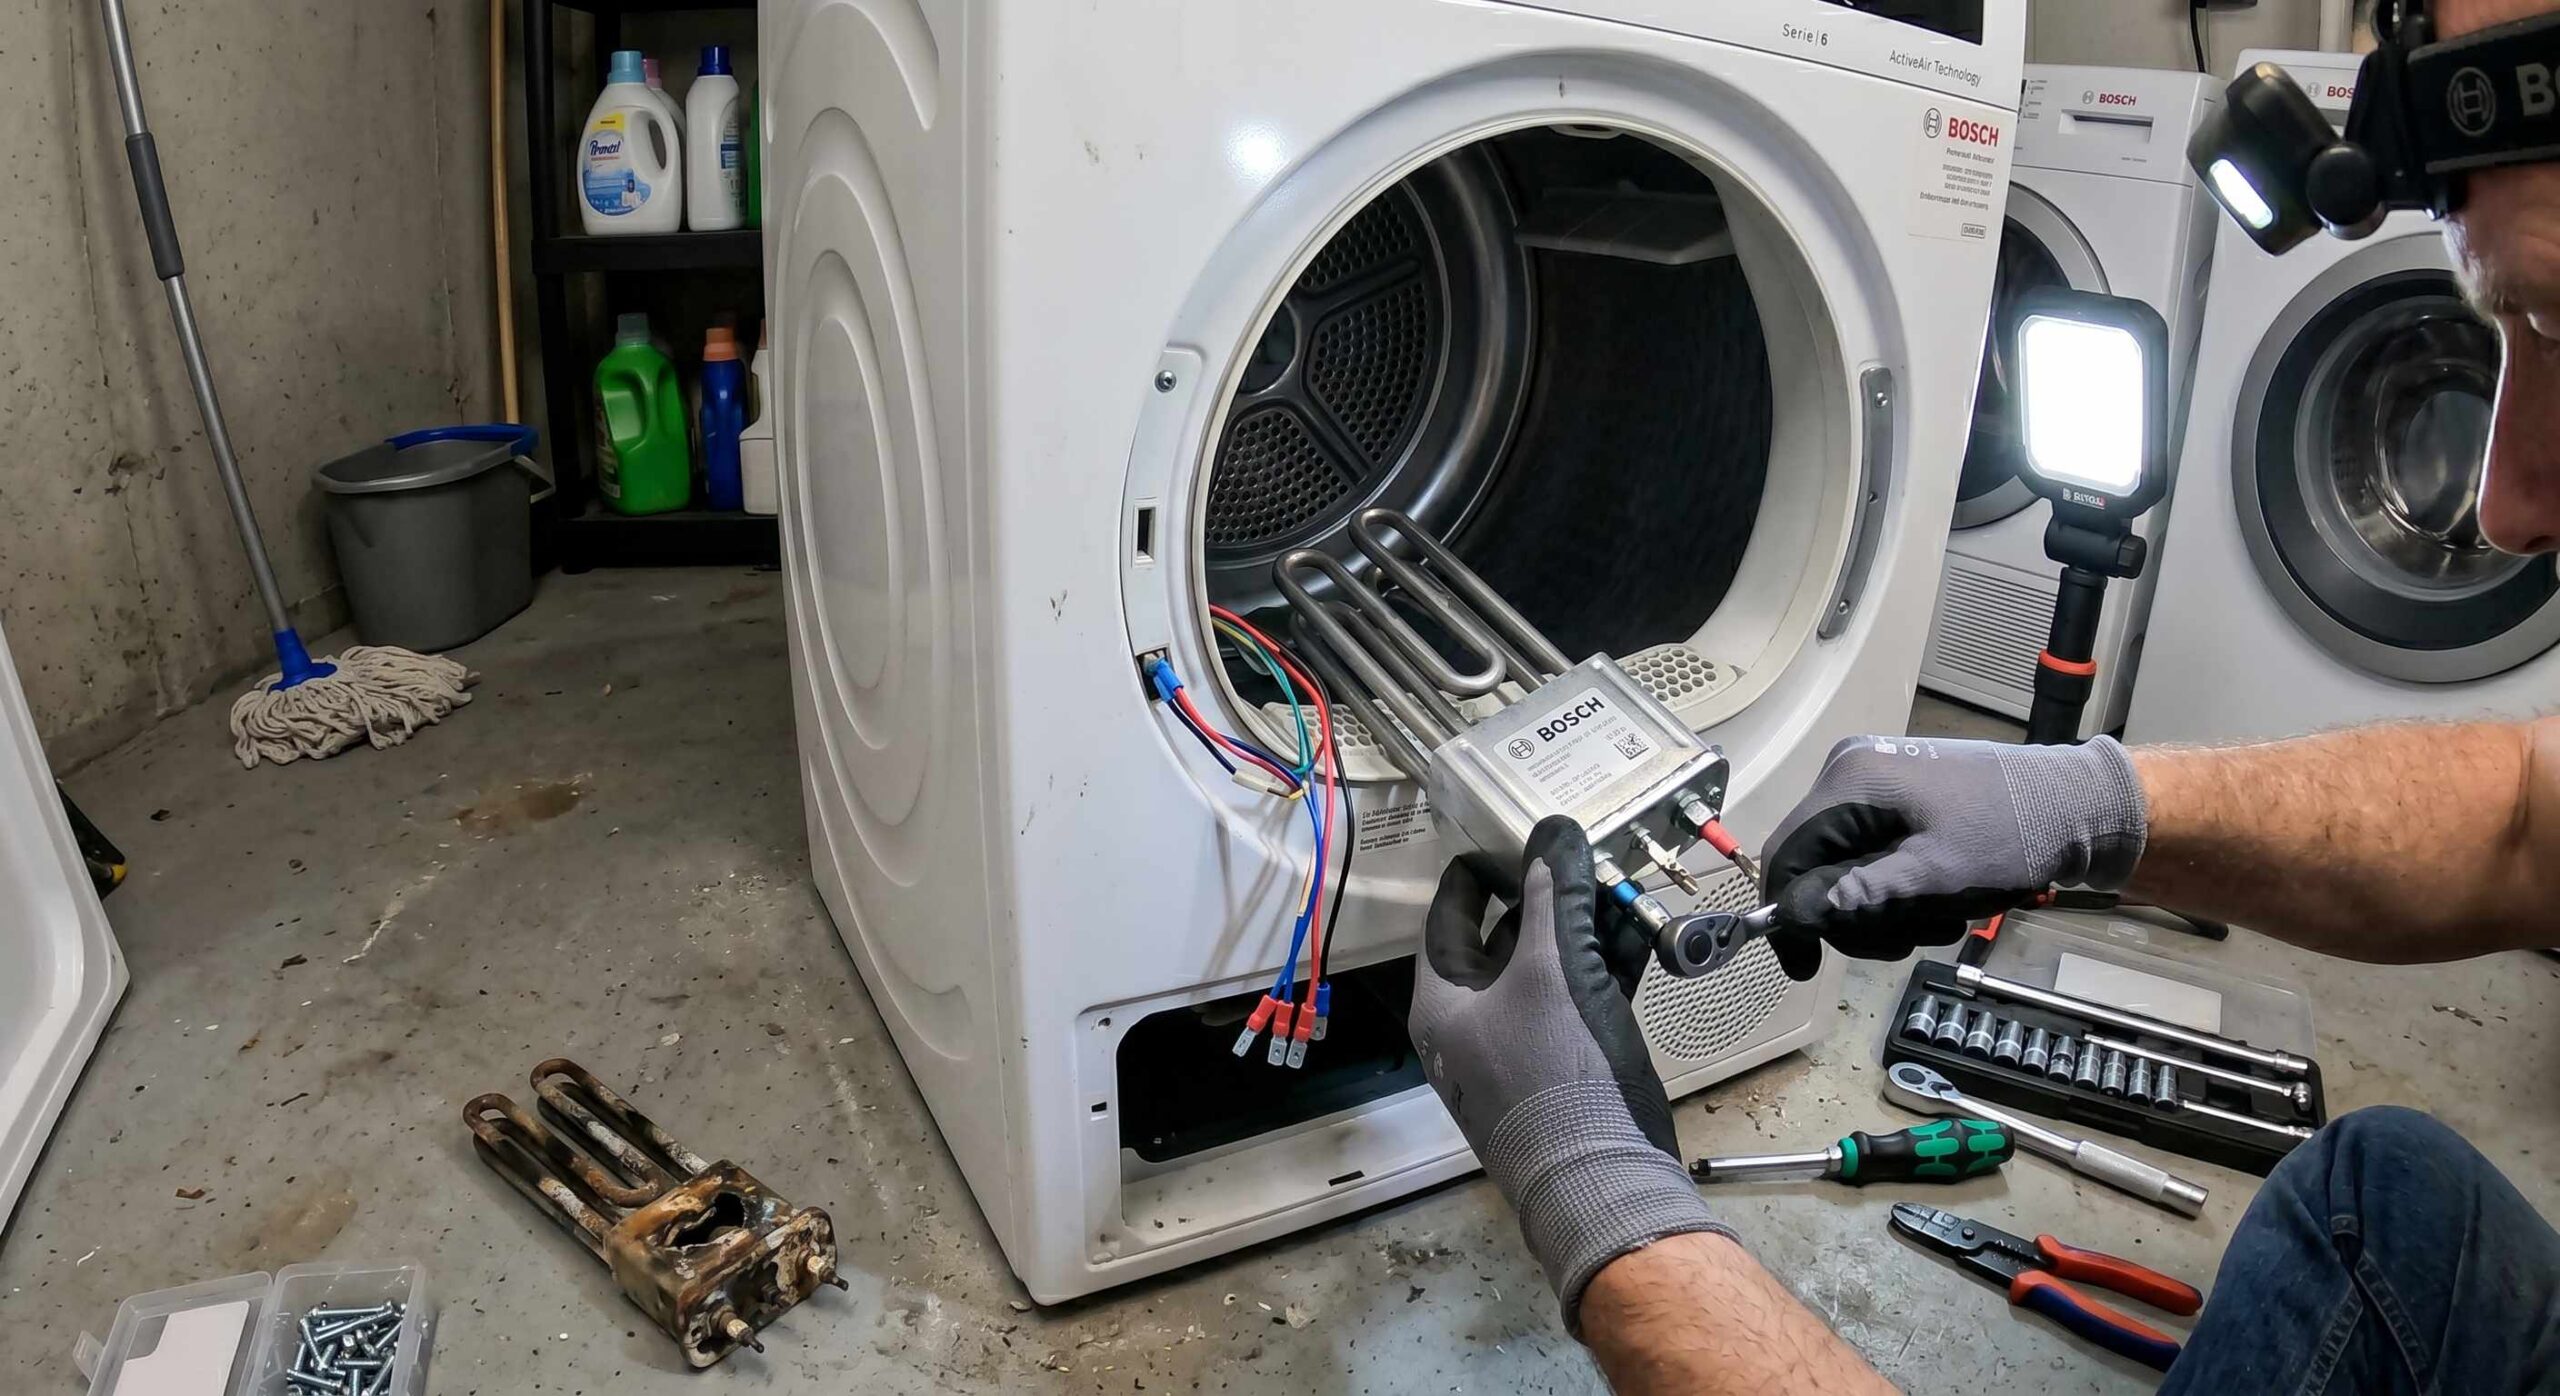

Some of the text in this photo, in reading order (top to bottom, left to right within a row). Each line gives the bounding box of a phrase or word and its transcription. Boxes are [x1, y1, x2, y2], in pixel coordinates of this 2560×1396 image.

[1889, 50, 1981, 88] ActiveAir Technology
[2098, 93, 2137, 106] BOSCH
[2515, 62, 2560, 116] B
[1948, 117, 1999, 147] BOSCH
[1536, 696, 1605, 743] BOSCH
